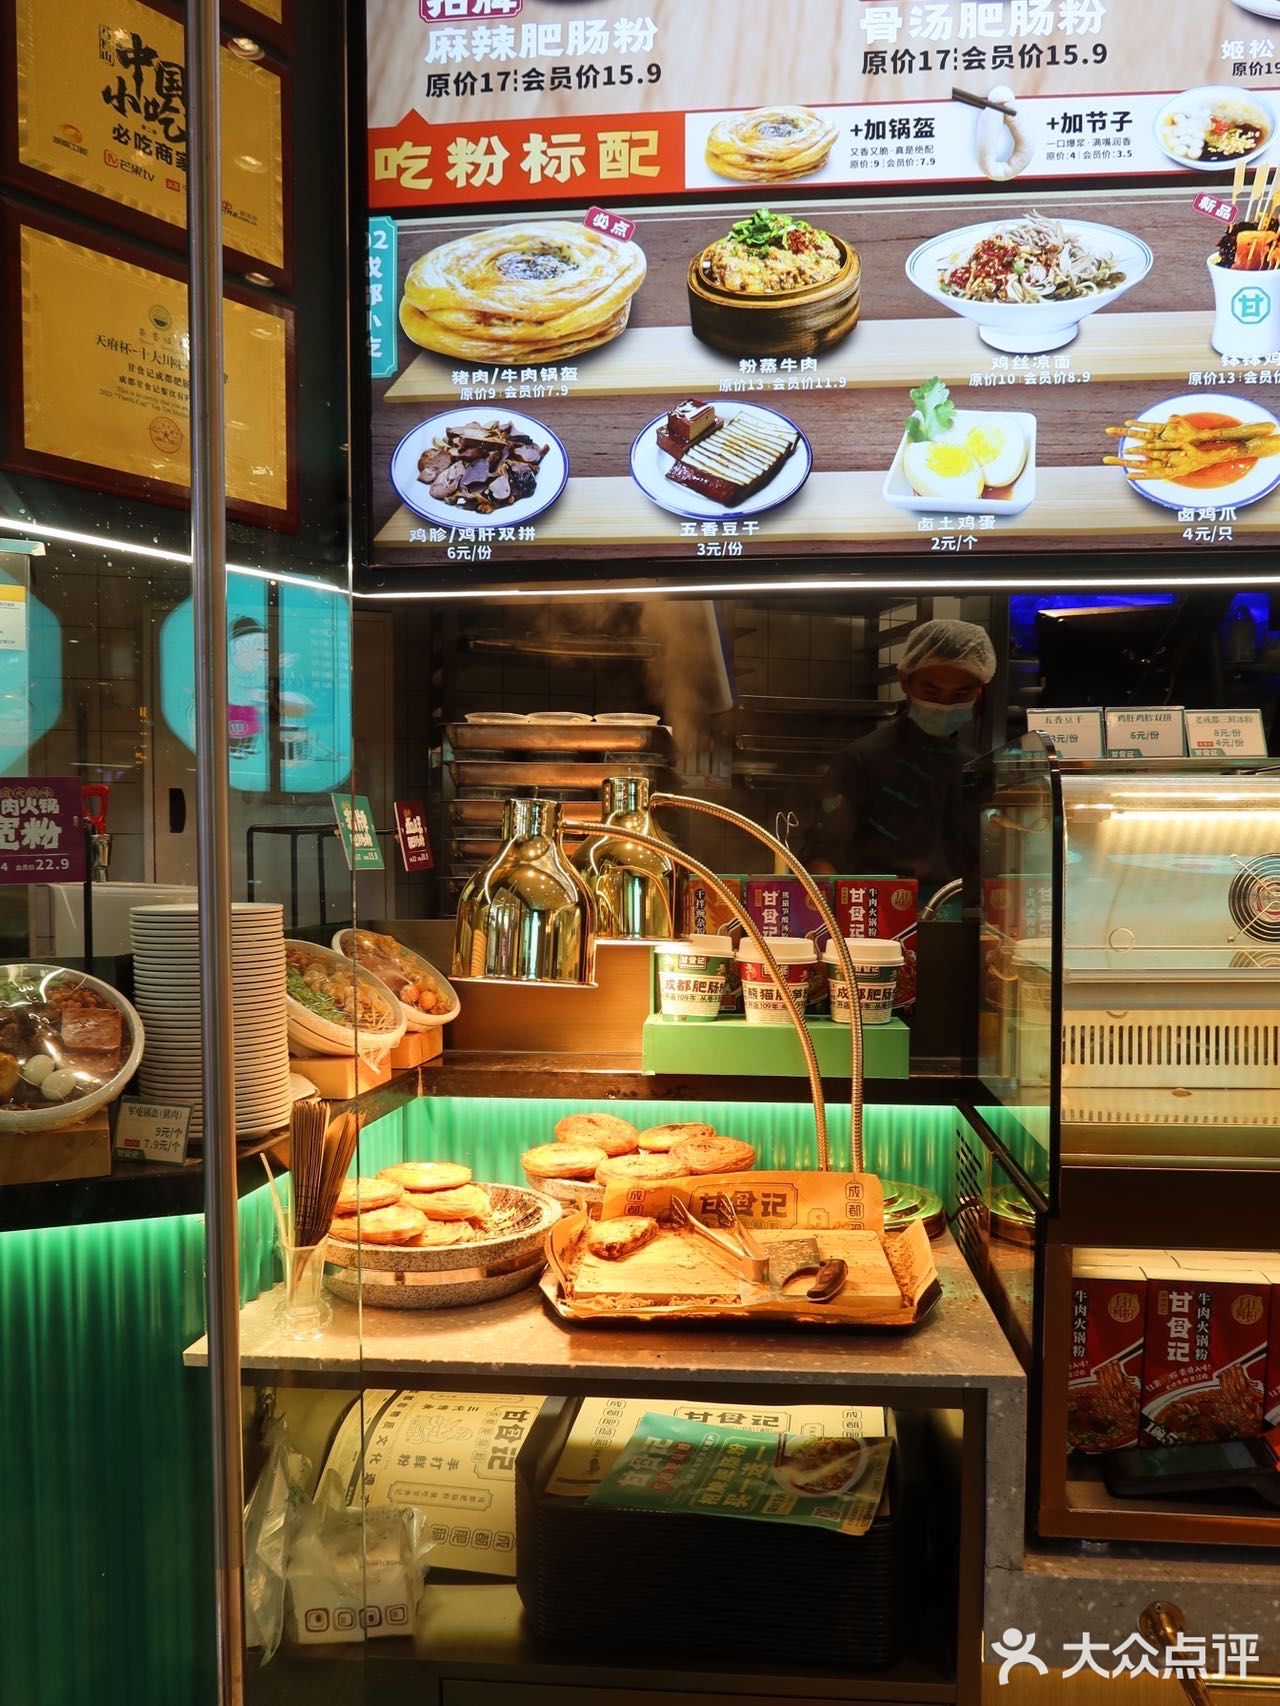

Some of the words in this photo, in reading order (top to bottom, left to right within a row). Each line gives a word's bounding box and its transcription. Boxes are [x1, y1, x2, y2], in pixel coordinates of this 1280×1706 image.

[860, 0, 1106, 45] 骨汤肥肠粉
[424, 16, 659, 64] 麻辣肥肠粉
[862, 48, 952, 76] 原价17
[962, 43, 1108, 73] 会员价15.9
[425, 70, 513, 99] 原价17
[522, 62, 663, 93] 会员价15.9
[850, 117, 936, 141] +加锅盔
[1046, 111, 1134, 135] +加节子
[374, 129, 661, 191] 吃粉标配
[1198, 196, 1232, 220] 新品
[592, 212, 632, 238] 必点
[738, 356, 819, 374] 粉蒸牛肉
[990, 354, 1072, 370] 鸡丝凉面
[451, 366, 579, 386] 猪肉/牛肉锅盔
[772, 376, 848, 391] 会员价11.9
[1024, 370, 1092, 386] 会员价8.9
[504, 384, 569, 400] 会员价7.9
[916, 514, 998, 532] 卤土鸡蛋
[1176, 506, 1238, 524] 卤鸡爪
[408, 526, 537, 544] 鸡胗/鸡肝双拼
[679, 520, 761, 538] 五香豆干
[1182, 526, 1234, 543] 4元/只
[696, 541, 745, 558] 3元/份
[931, 535, 979, 552] 2元/个
[446, 544, 493, 562] 6元/份
[1045, 714, 1084, 725] 五香豆干
[1130, 730, 1160, 741] 6元/份
[1214, 728, 1241, 738] 8元/份
[1215, 738, 1244, 748] 4元/份
[849, 887, 866, 938] 甘食记
[155, 1127, 184, 1140] 9元/个
[144, 1139, 182, 1154] 7.9元/个
[1072, 1289, 1088, 1358] 牛肉火锅粉
[1166, 1291, 1193, 1363] 甘食记
[1194, 1292, 1211, 1361] 牛肉火锅粉
[684, 1411, 780, 1428] 甘食记
[488, 1409, 530, 1472] 甘食记
[398, 1453, 460, 1472] 手打鲜粉
